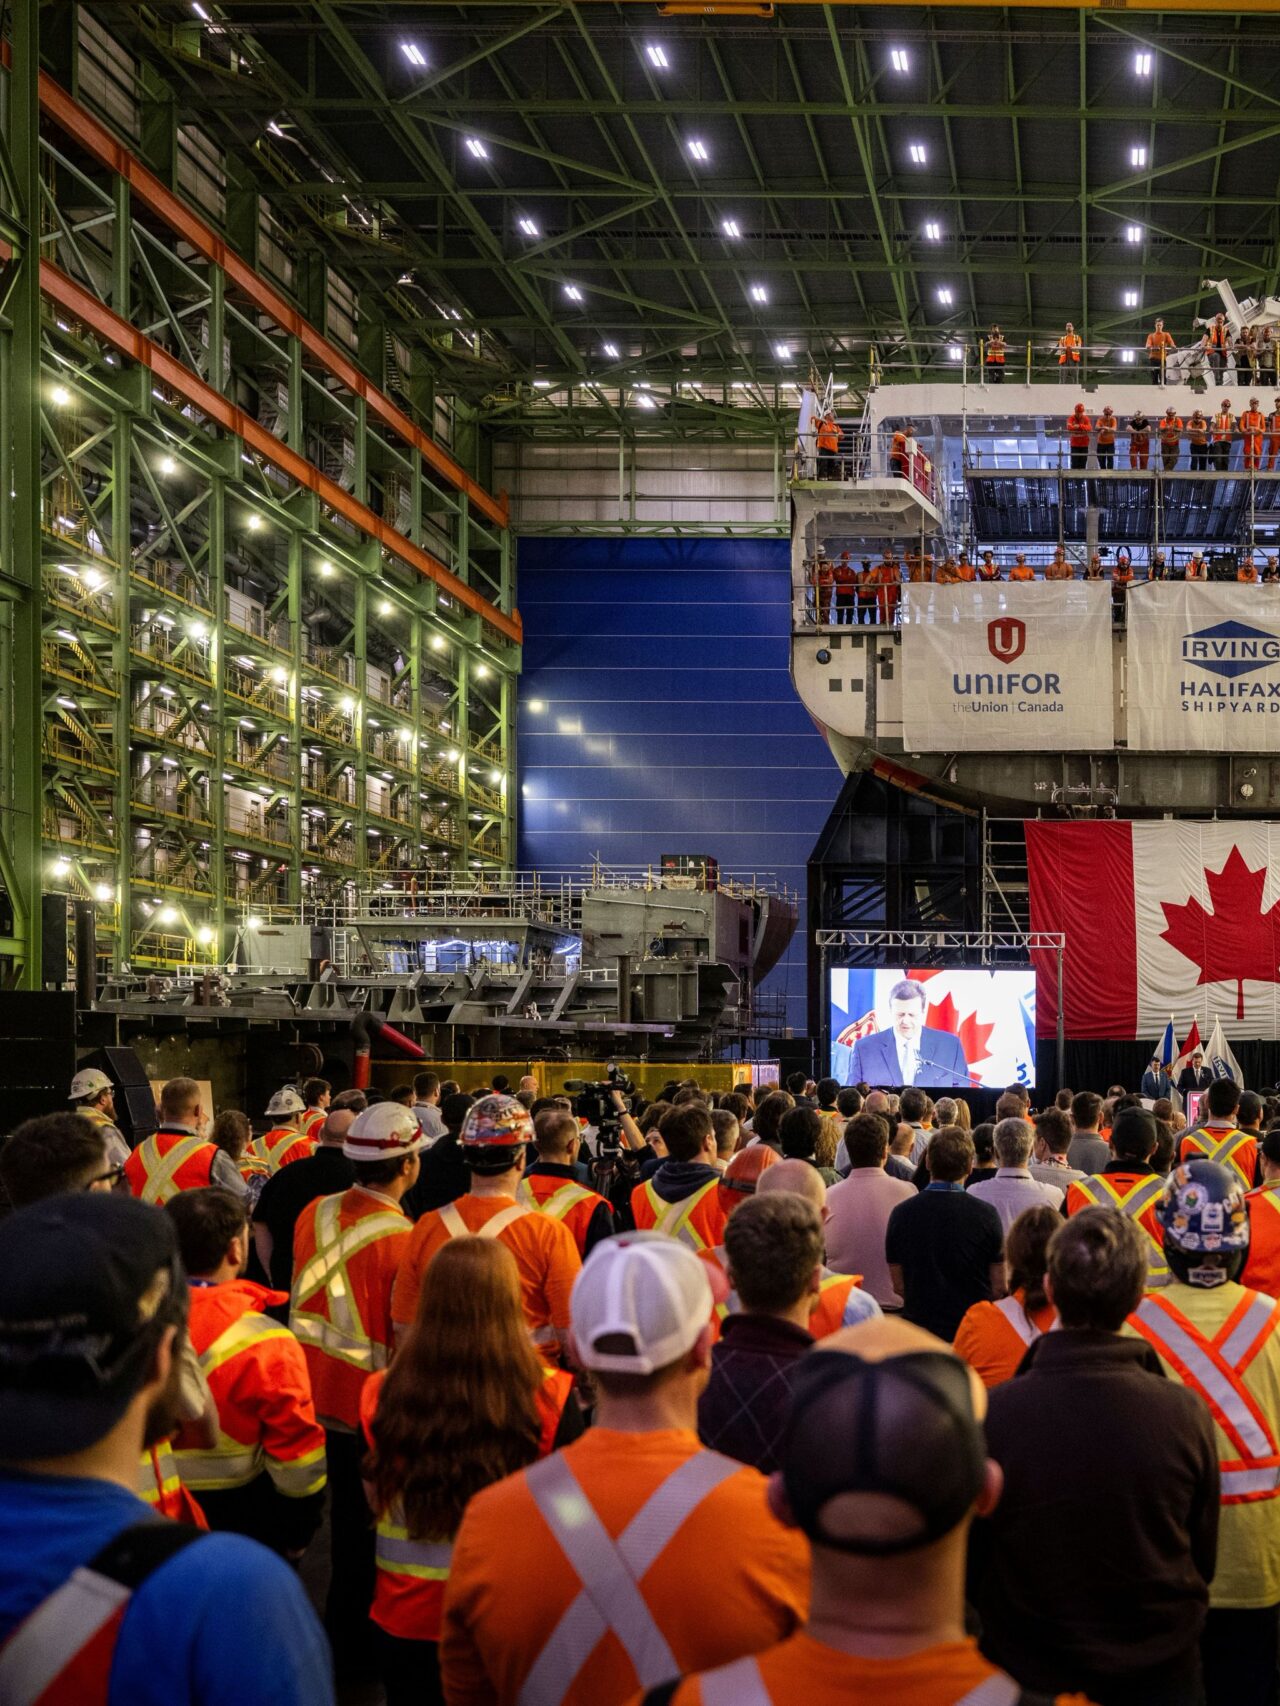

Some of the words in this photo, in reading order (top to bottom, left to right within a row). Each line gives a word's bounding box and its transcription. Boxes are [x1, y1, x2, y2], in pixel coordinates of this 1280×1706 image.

[1182, 640, 1280, 658] IRVING
[1018, 701, 1064, 713] Canada
[1181, 700, 1280, 713] SHIPYARD
